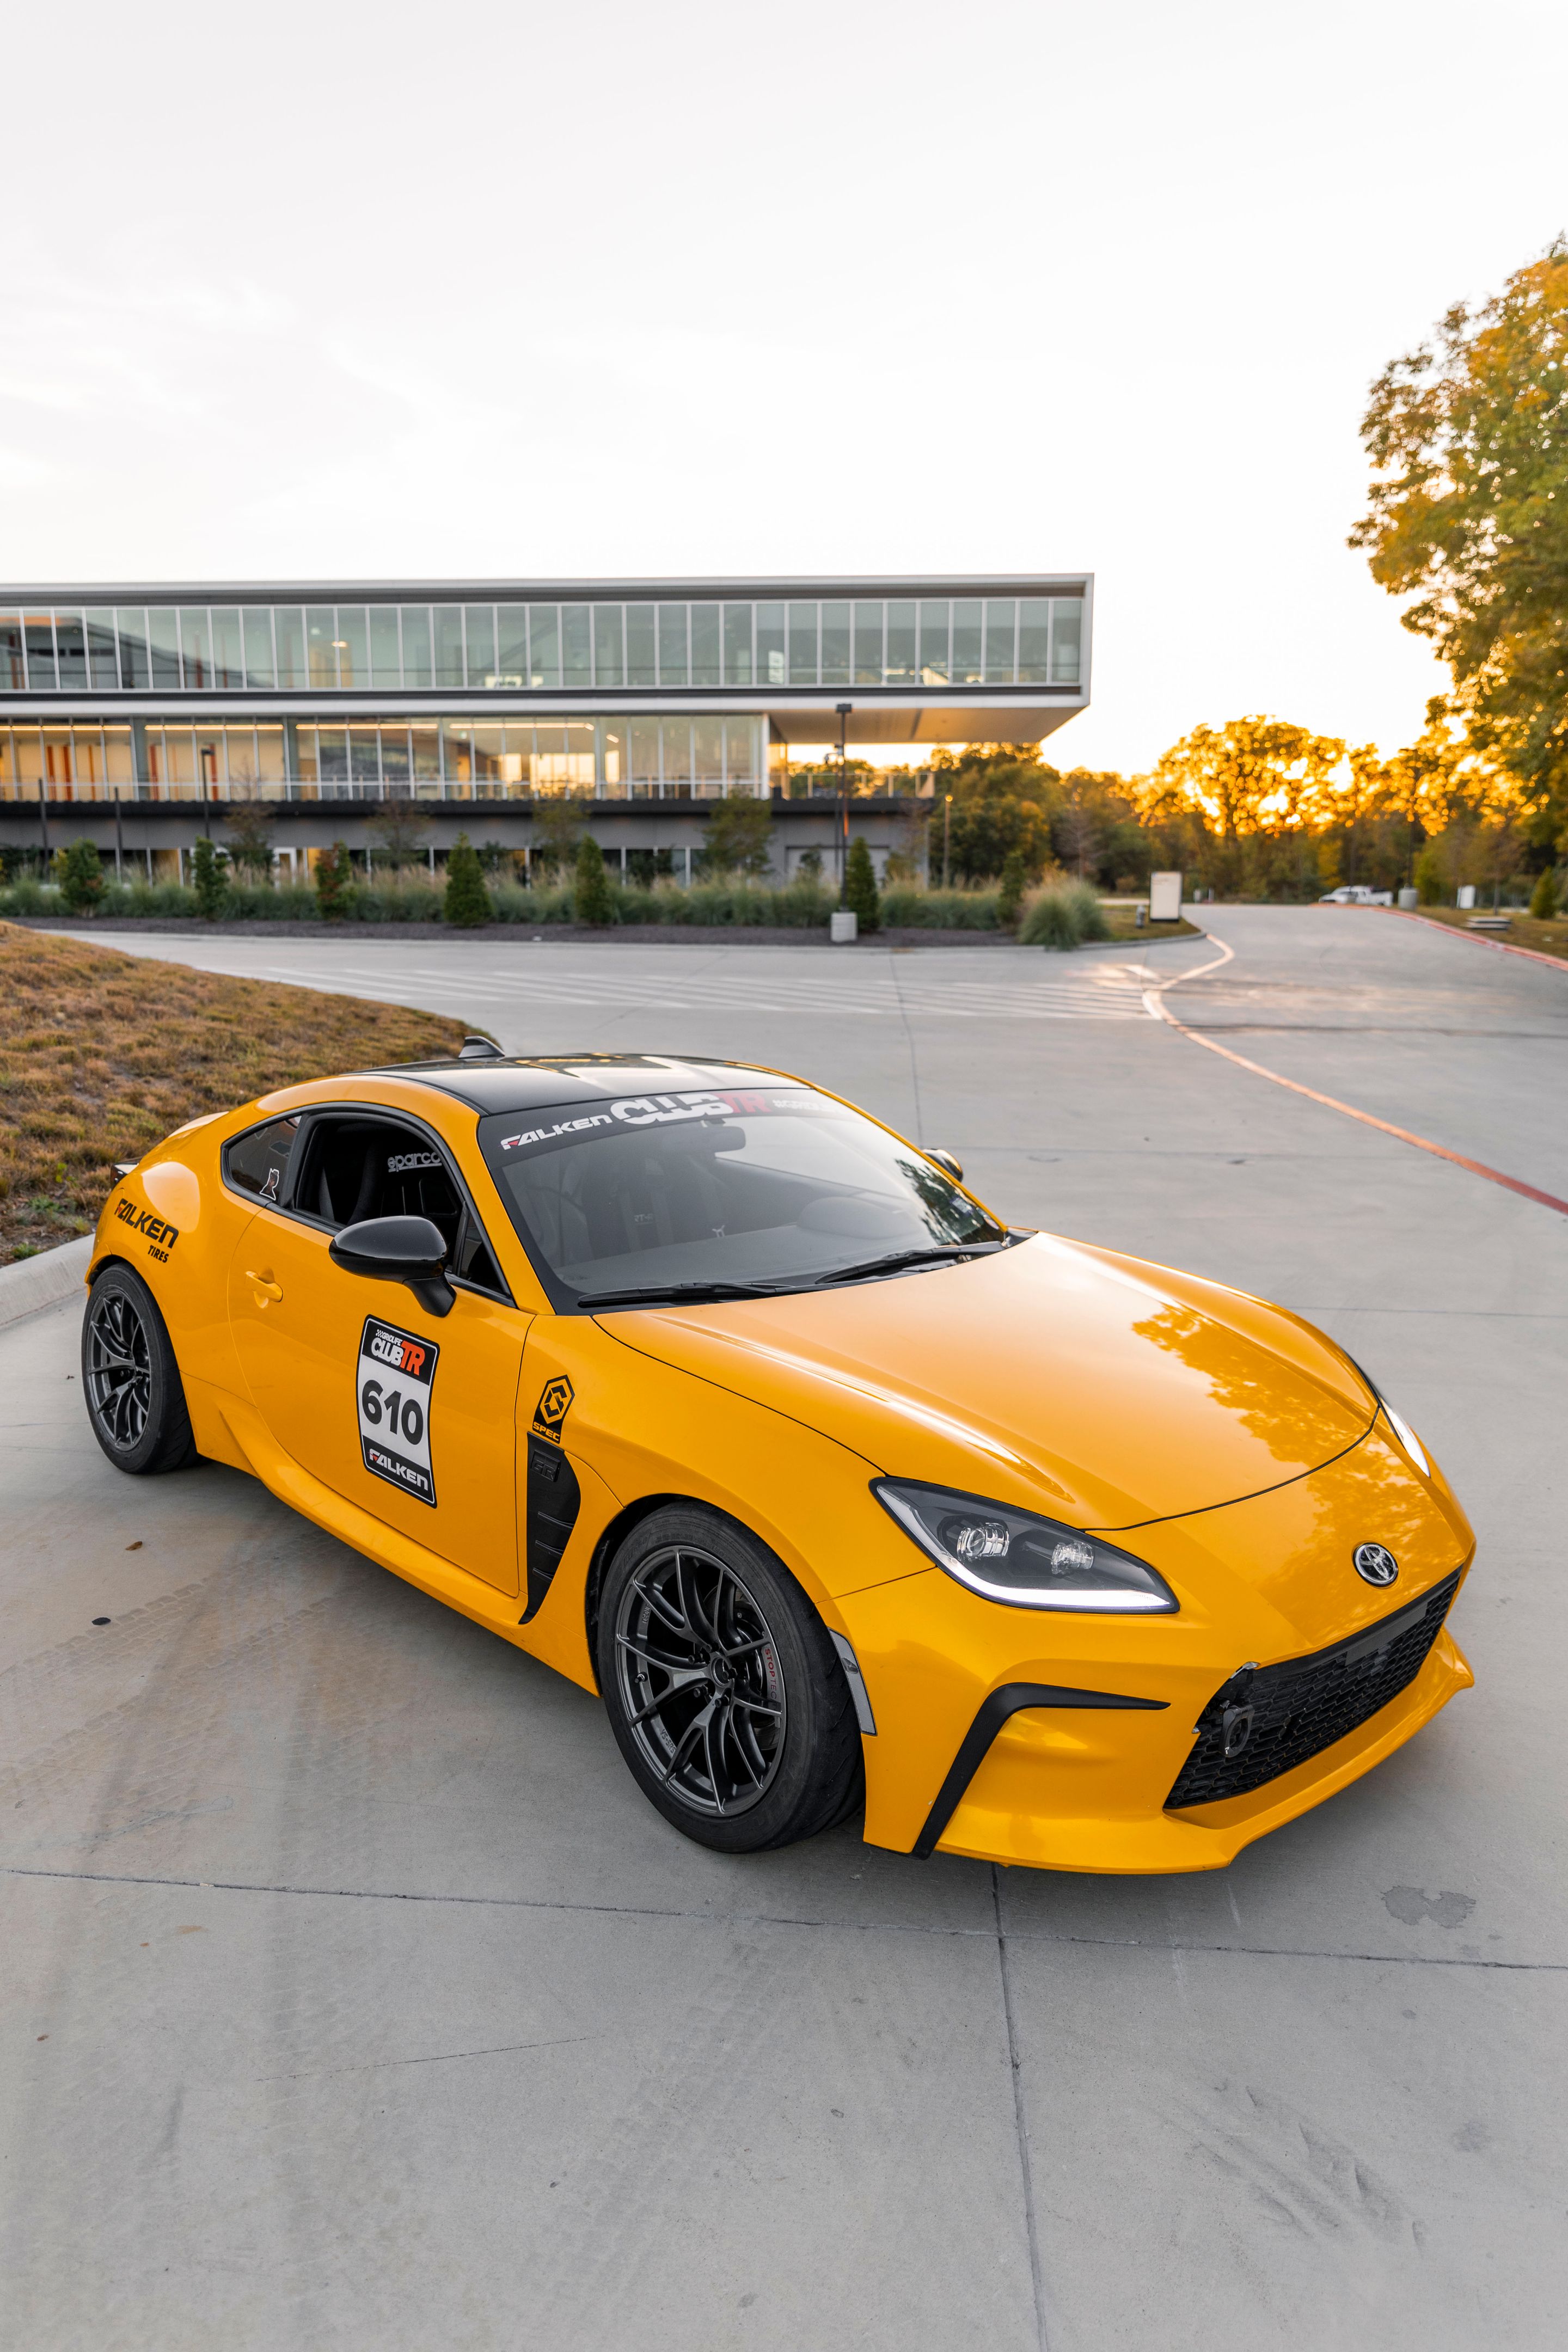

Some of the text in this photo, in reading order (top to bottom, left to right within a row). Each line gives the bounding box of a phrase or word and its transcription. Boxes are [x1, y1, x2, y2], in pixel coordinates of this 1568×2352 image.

[500, 1114, 613, 1150] FALKEN
[114, 1198, 179, 1249] FALKEN
[148, 1245, 169, 1263] TIRES
[362, 1380, 424, 1445] 610
[533, 1421, 560, 1441] SPEC
[369, 1448, 428, 1491] FALKEN
[765, 1648, 777, 1699] STOPTEC
